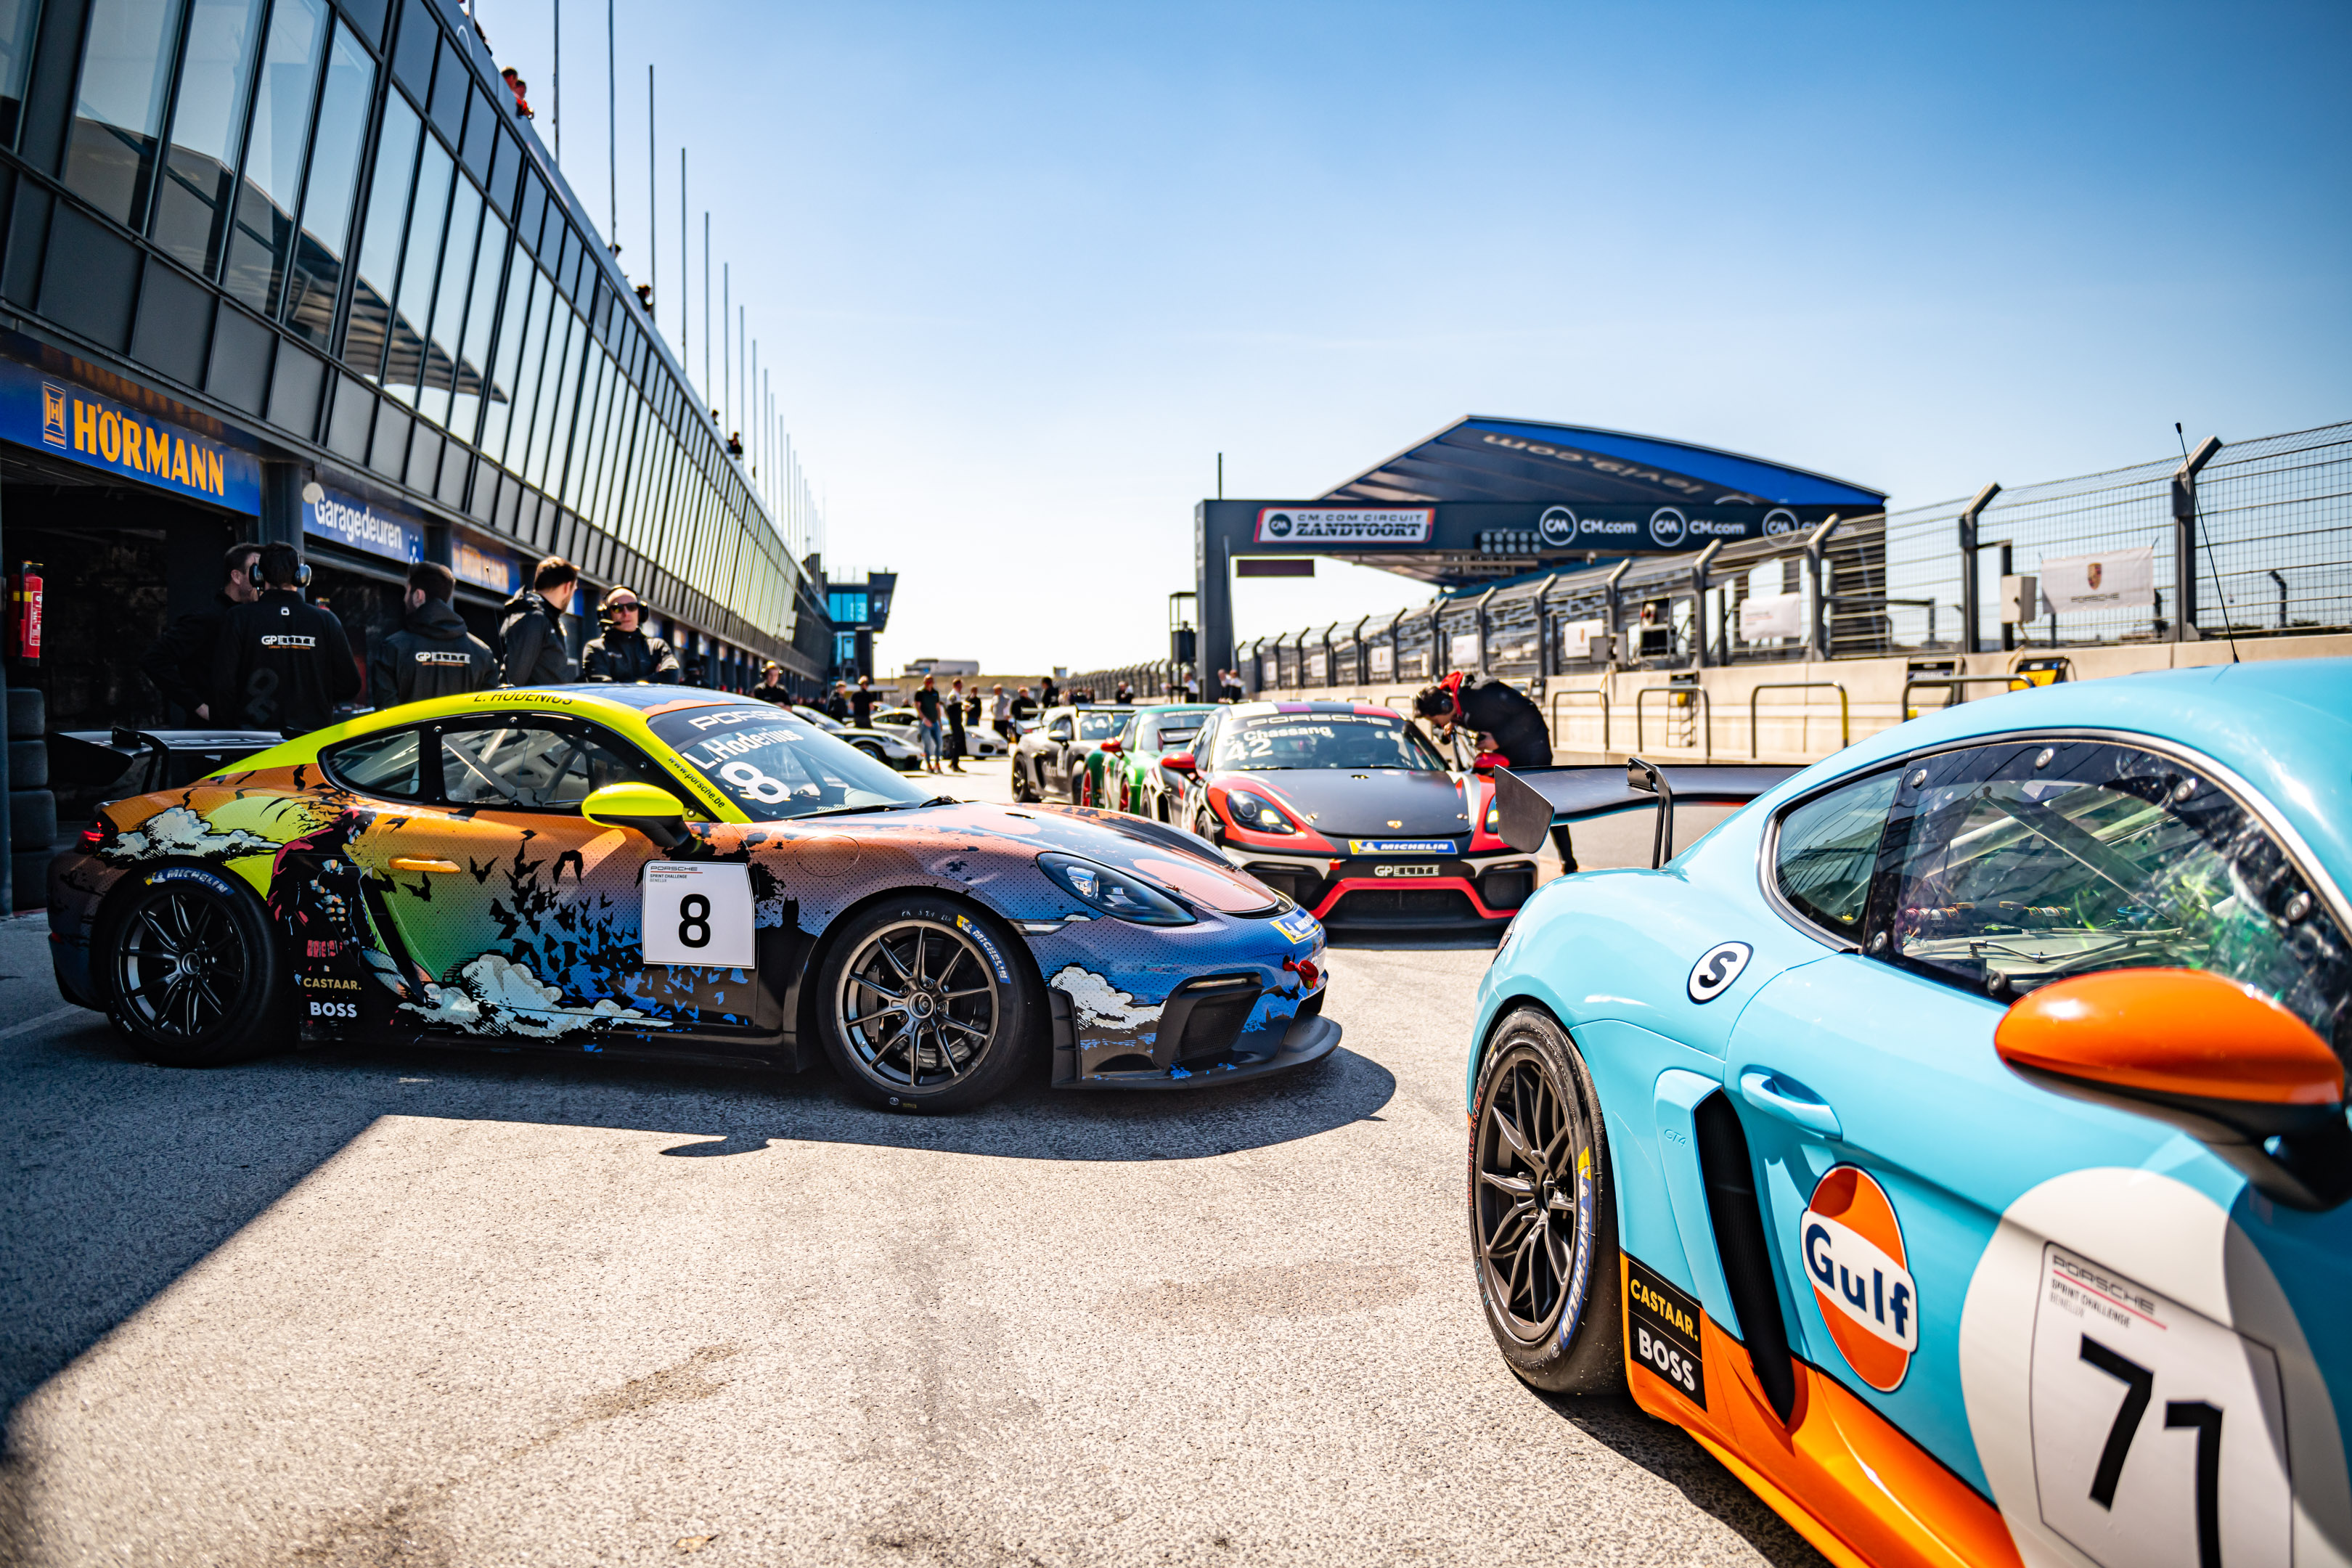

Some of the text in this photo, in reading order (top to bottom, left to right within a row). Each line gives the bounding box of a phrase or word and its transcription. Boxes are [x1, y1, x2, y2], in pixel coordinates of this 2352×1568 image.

[74, 399, 224, 497] HÖRMANN
[314, 491, 403, 550] Garagedeuren
[1296, 523, 1421, 536] ZANDVOORT
[1580, 513, 1637, 534] CM.com
[1689, 513, 1746, 535] CM.com
[1244, 726, 1333, 741] Chassang
[1246, 714, 1392, 727] PORSCHE
[1225, 738, 1273, 761] 42
[668, 756, 725, 809] www.porsche.be
[720, 761, 791, 804] 8
[167, 870, 228, 893] MICHELIN
[678, 894, 711, 948] 8
[972, 930, 1008, 979] MICHELIN
[1698, 951, 1737, 988] S
[303, 978, 362, 990] CASTAAR.
[310, 1002, 357, 1017] BOSS
[1664, 1129, 1686, 1147] GT4
[1561, 1204, 1590, 1338] MICHELIN
[1805, 1223, 1910, 1339] Gulf
[2053, 1254, 2155, 1315] PORSCHE
[1630, 1279, 1699, 1342] CASTAAR.
[2051, 1278, 2131, 1328] SPRINT CHALLENGE
[1638, 1327, 1695, 1391] BOSS
[2079, 1333, 2224, 1568] 71
